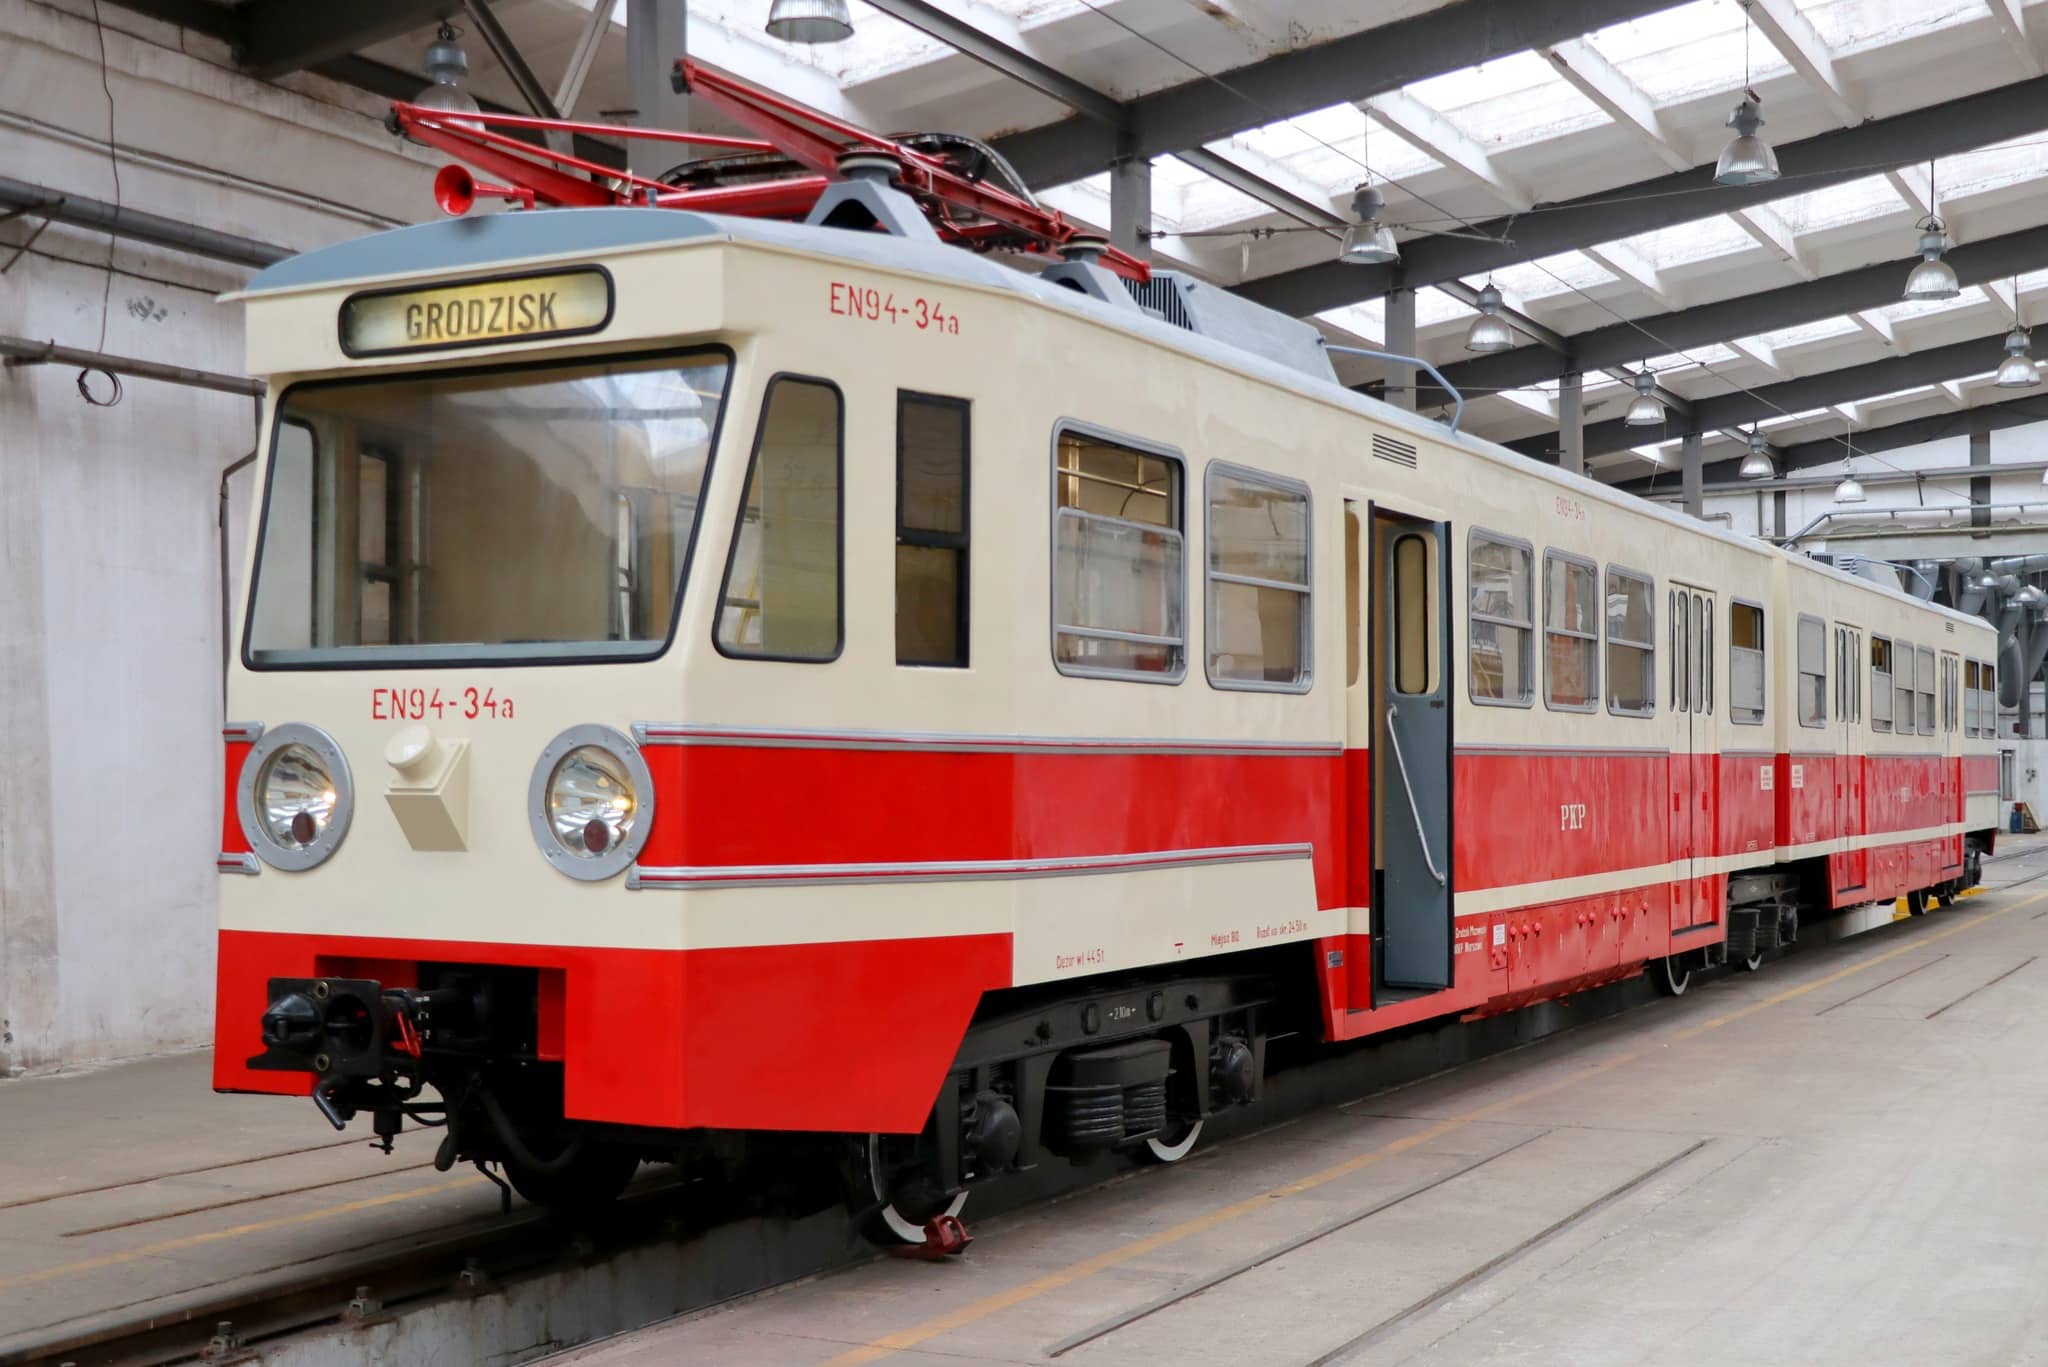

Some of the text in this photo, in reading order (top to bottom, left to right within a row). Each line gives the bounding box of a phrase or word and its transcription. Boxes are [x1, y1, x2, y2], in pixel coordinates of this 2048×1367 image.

[406, 291, 559, 342] GRODZISK
[830, 281, 960, 336] EN94-34a
[372, 686, 515, 721] EN94-34a
[1560, 803, 1586, 831] PKP
